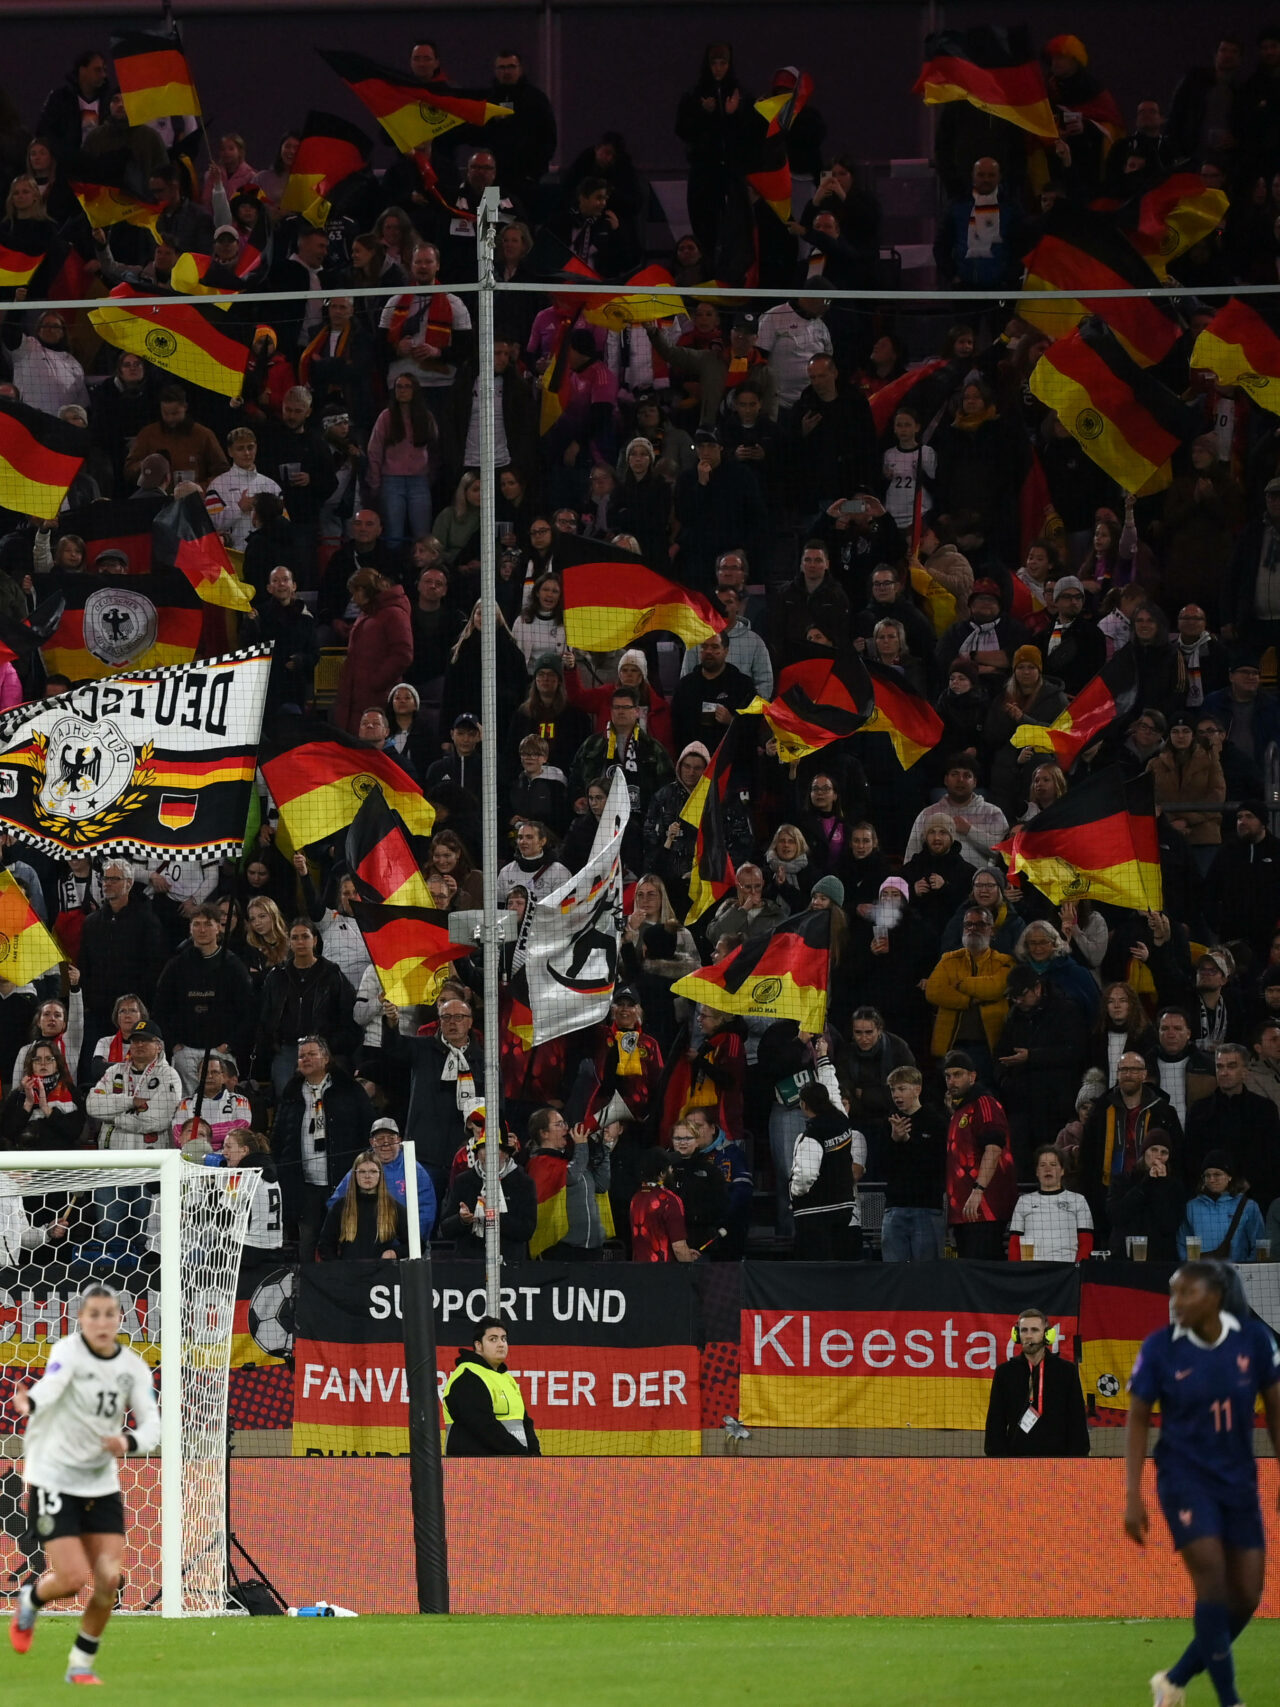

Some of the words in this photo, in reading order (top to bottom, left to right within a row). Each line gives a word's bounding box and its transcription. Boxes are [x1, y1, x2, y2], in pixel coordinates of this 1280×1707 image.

[895, 476, 913, 489] 22
[539, 722, 555, 739] 11
[135, 1021, 147, 1030] B
[369, 1284, 540, 1323] SPORT
[552, 1286, 626, 1324] UND
[612, 1369, 688, 1408] DER
[95, 1390, 118, 1418] 13
[1209, 1399, 1232, 1432] 11
[37, 1487, 63, 1516] 13
